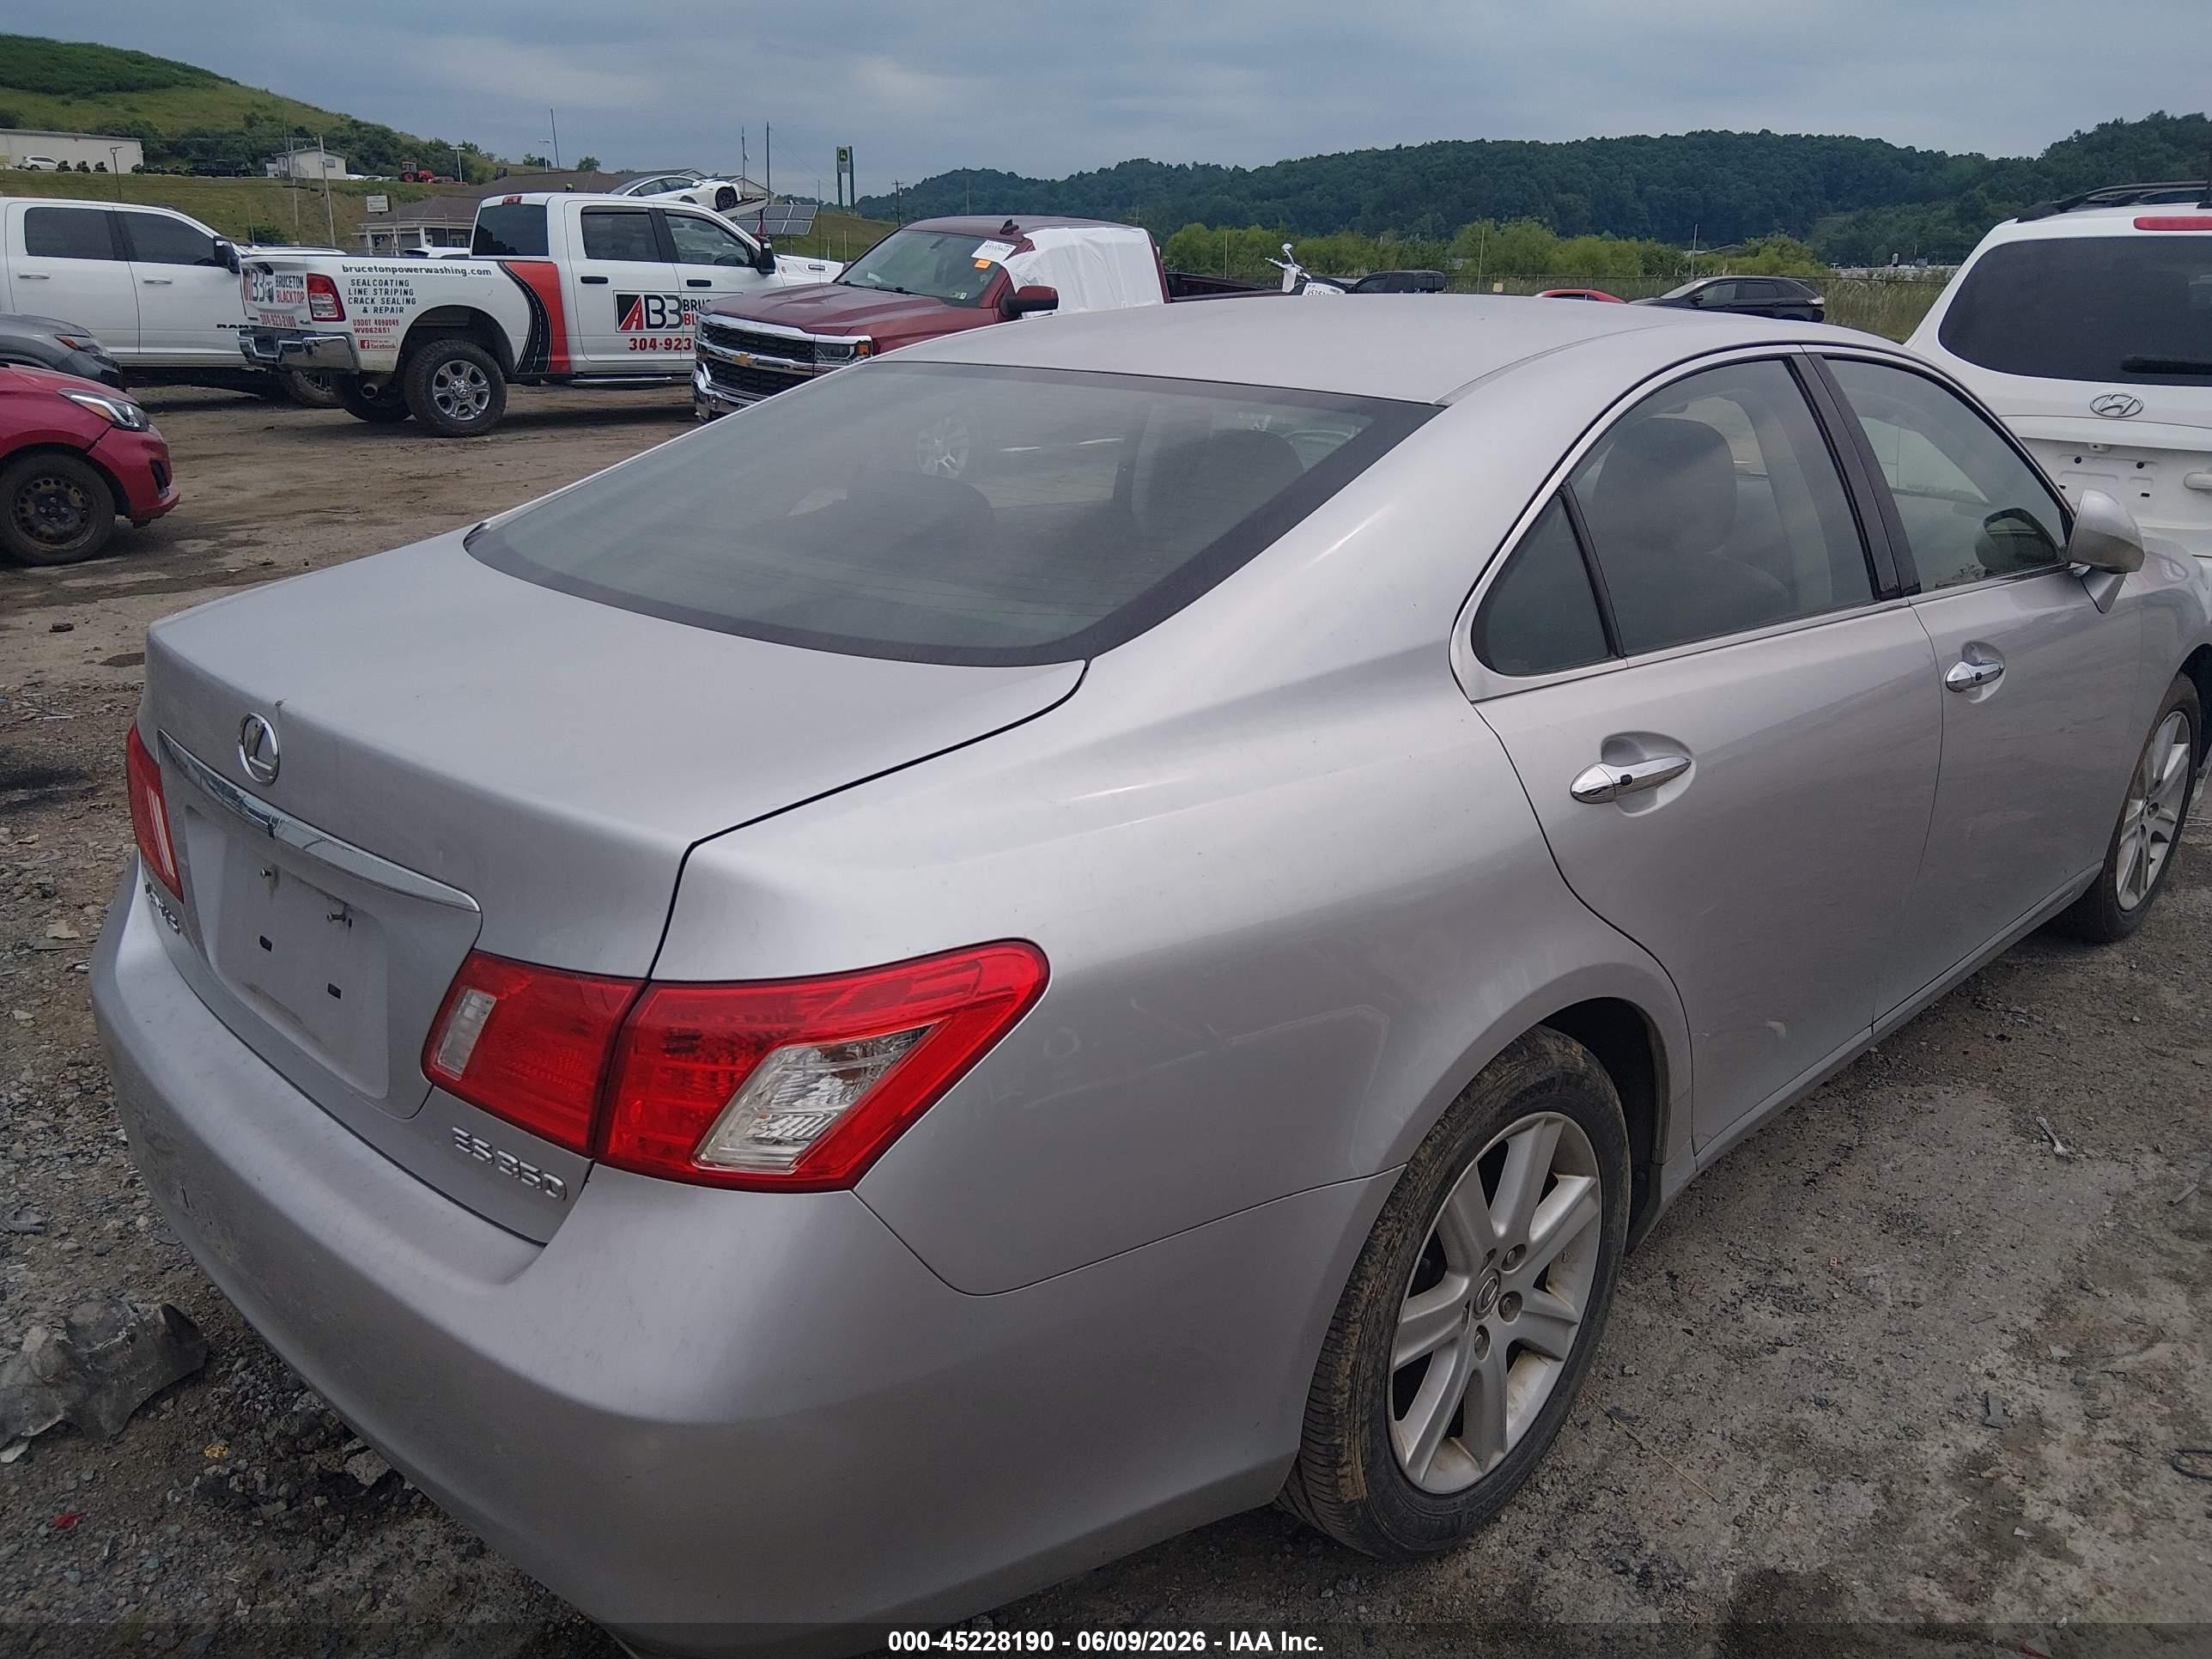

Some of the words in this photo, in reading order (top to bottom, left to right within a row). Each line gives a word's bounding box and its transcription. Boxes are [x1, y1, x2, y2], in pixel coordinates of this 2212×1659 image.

[342, 264, 492, 277] brucetonpowerwashing.com
[275, 275, 305, 289] BRUCETON
[350, 278, 410, 288] SEALCOATING
[348, 288, 368, 296] LINE
[380, 297, 416, 306] SEALING
[683, 299, 712, 312] BRU
[497, 1150, 568, 1202] 350
